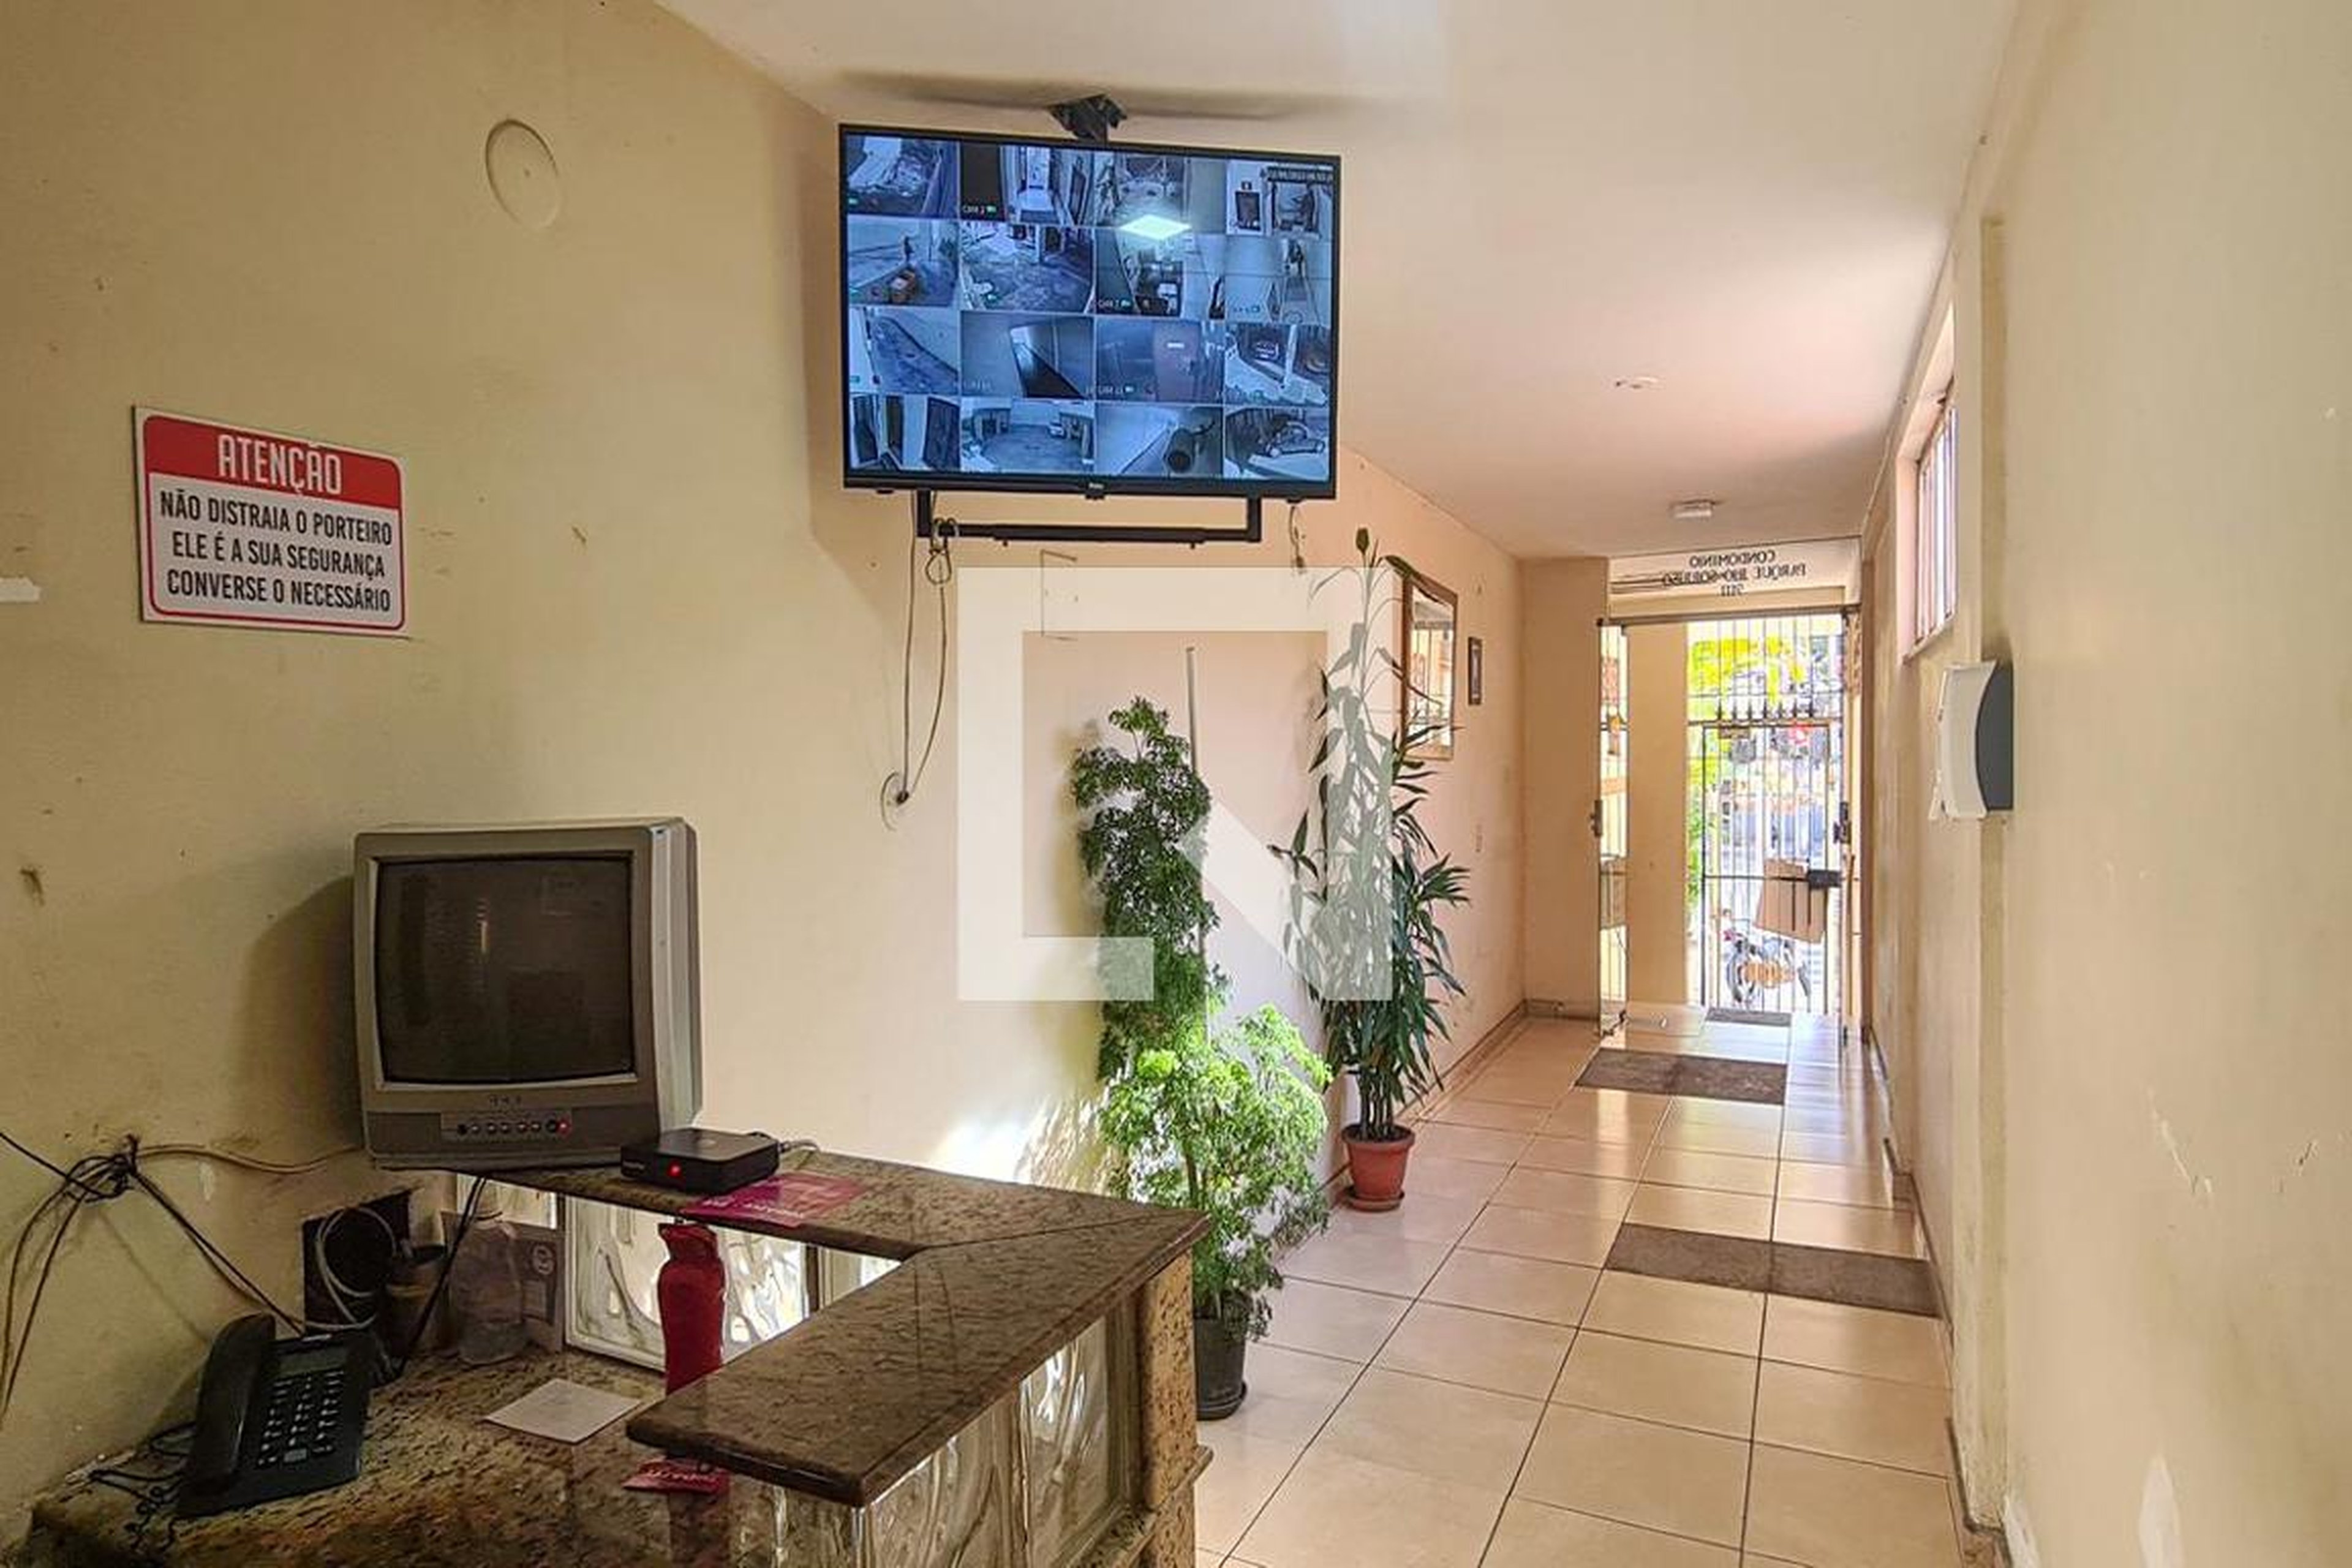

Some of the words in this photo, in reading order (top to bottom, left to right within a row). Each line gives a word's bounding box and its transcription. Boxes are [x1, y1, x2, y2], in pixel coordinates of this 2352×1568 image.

[218, 434, 342, 496] ATENÇÃO
[160, 489, 201, 521] NÃO
[208, 499, 290, 532] DISTRAIA
[296, 510, 307, 534] O
[313, 513, 393, 546] PORTEIRO
[173, 531, 208, 560] ELE
[214, 531, 225, 561] É
[232, 539, 243, 562] A
[248, 540, 282, 567] SUA
[287, 545, 385, 581] SEGURANÇA
[167, 569, 267, 601] CONVERSE
[273, 579, 285, 603] O
[291, 579, 391, 612] NECESSÁRIO
